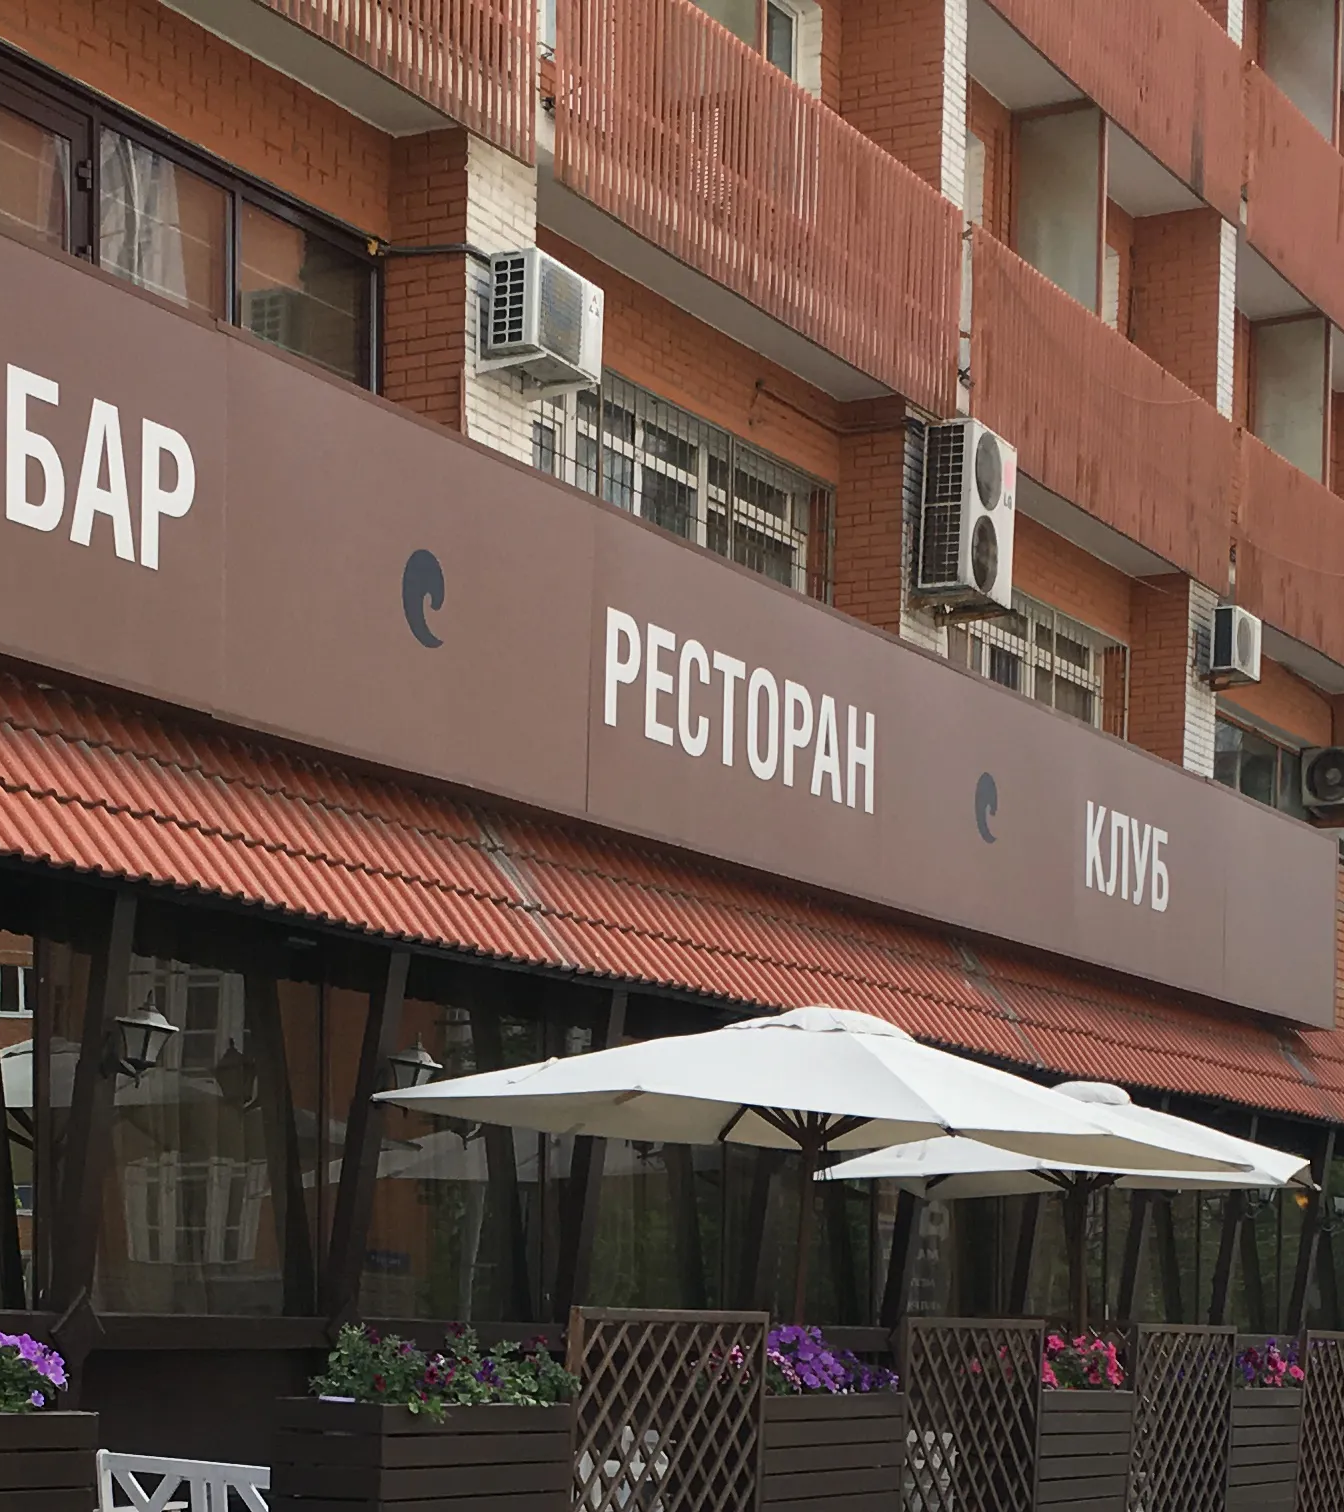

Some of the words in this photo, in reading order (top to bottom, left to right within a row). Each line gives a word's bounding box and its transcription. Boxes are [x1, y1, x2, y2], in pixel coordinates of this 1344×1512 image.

[4, 362, 197, 572] БАР
[603, 605, 877, 815] РЕСТОРАН
[1084, 799, 1170, 913] КЛУБ
